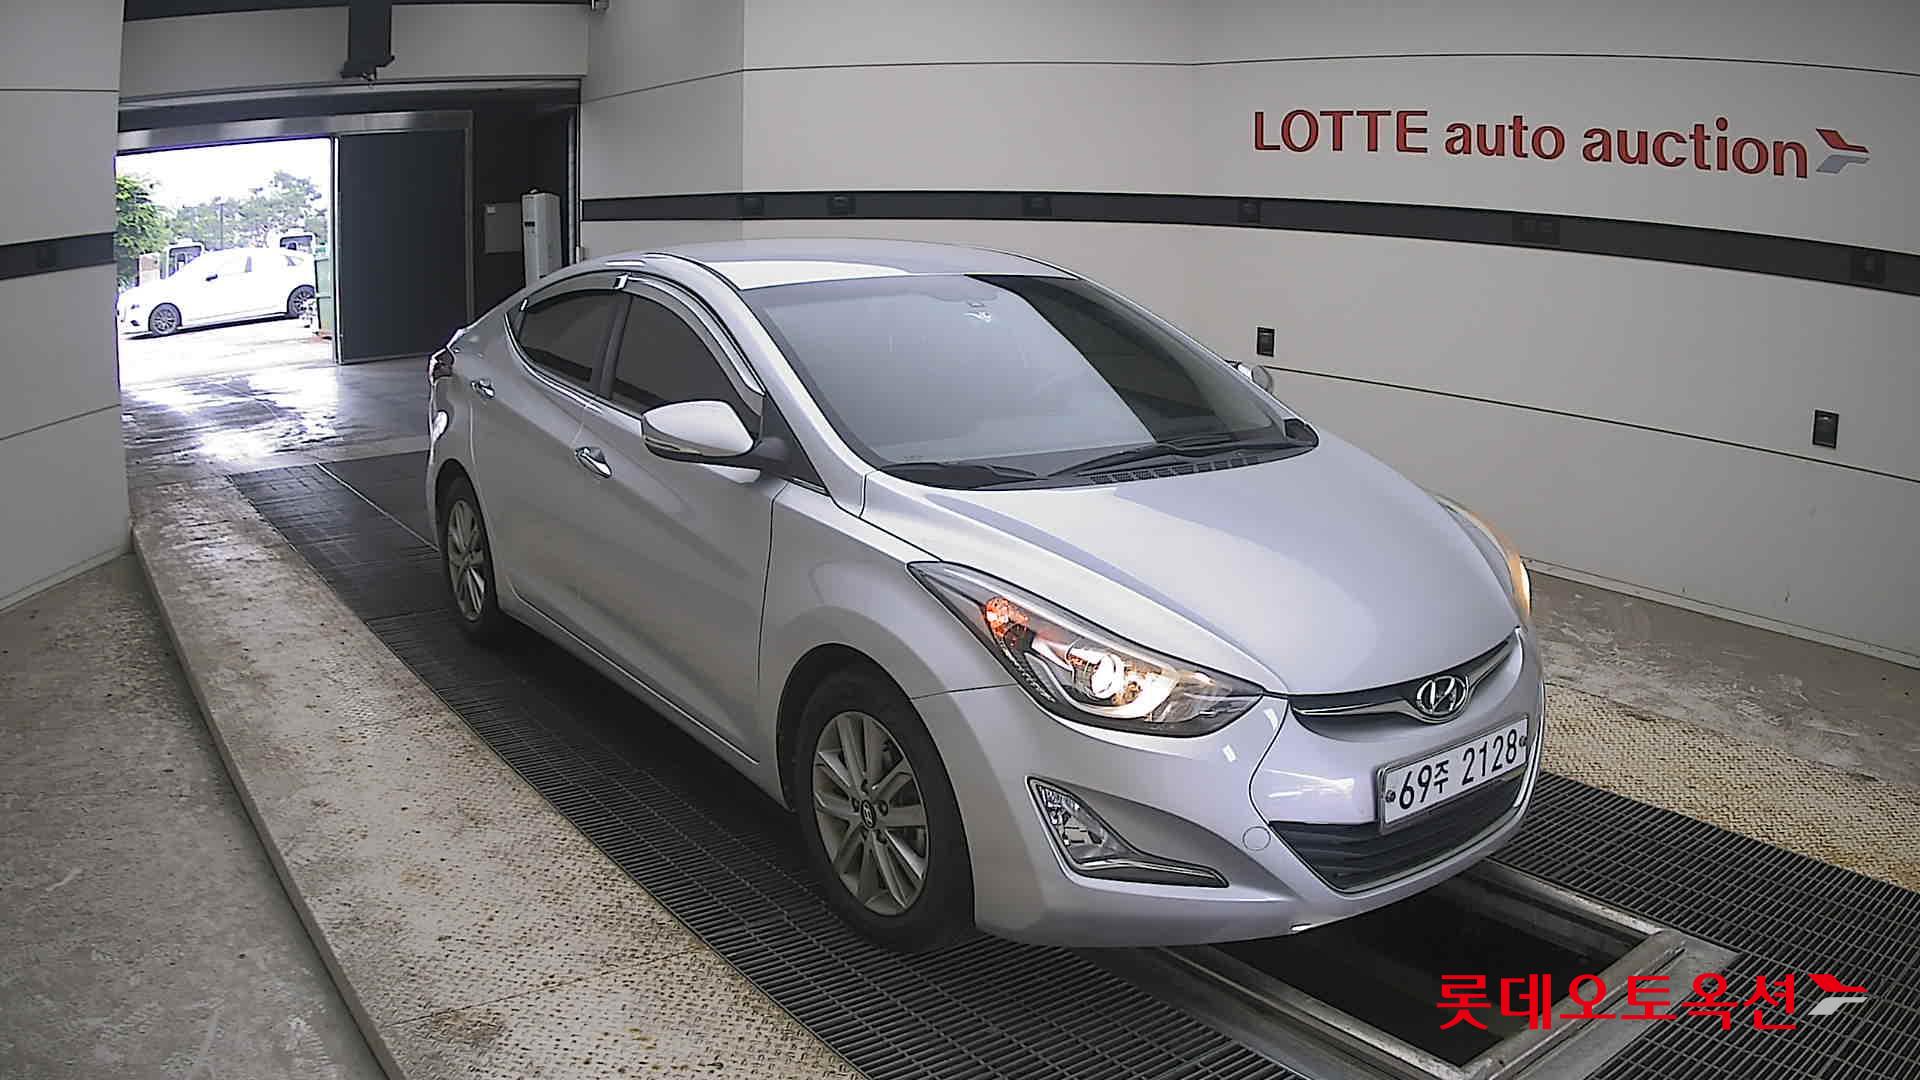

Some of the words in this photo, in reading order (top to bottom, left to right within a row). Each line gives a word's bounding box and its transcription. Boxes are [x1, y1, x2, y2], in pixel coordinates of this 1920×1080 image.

[1253, 109, 1428, 154] LOTTE
[1444, 114, 1566, 160] auto
[1582, 116, 1809, 179] auction
[1399, 759, 1450, 810] 69주
[1460, 728, 1518, 786] 2128
